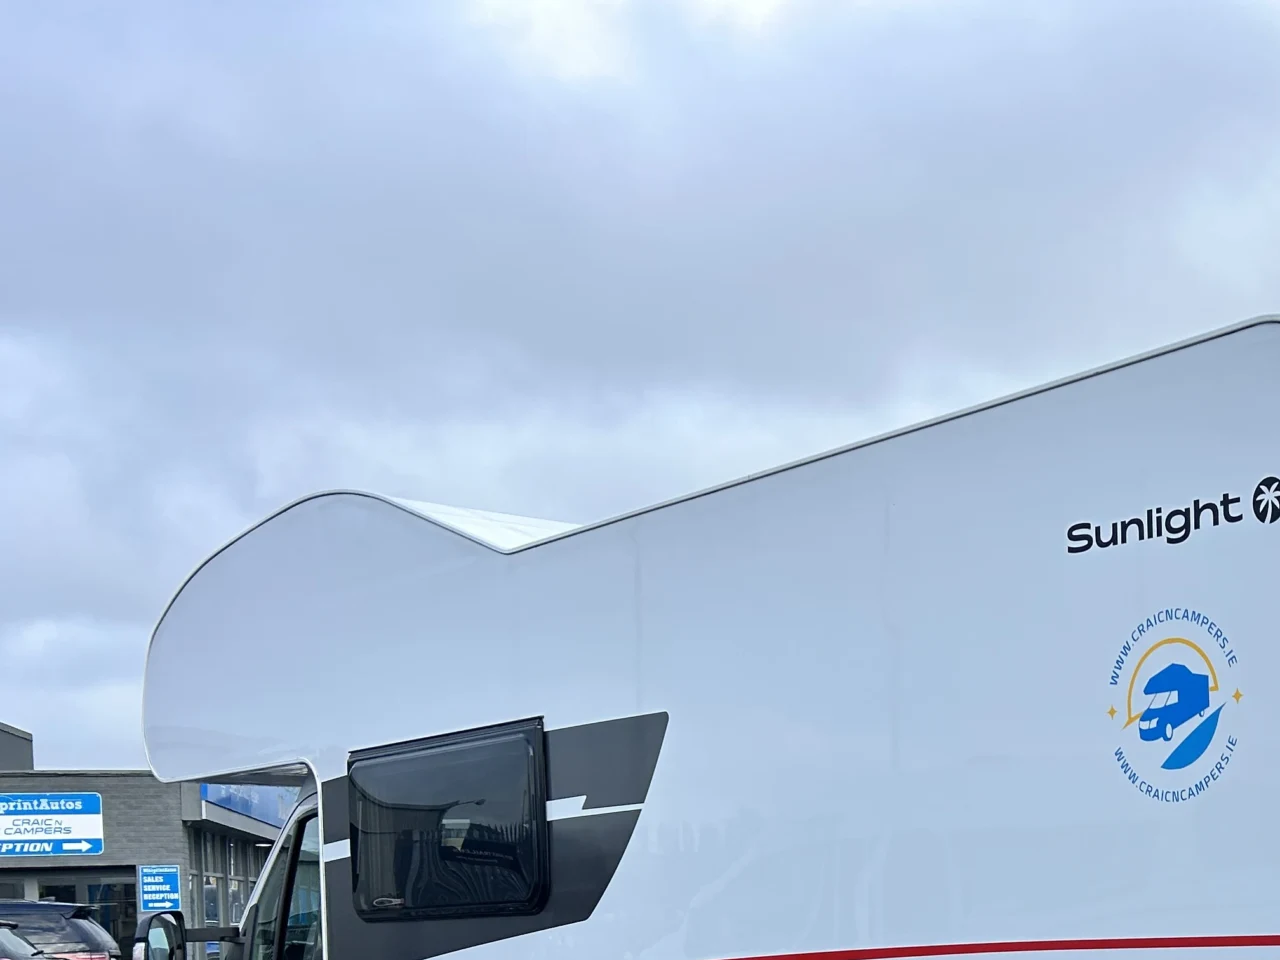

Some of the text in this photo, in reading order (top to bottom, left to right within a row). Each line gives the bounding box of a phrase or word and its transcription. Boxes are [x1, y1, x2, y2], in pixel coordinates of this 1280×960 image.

[1067, 492, 1243, 554] Sunlight
[1109, 607, 1238, 687] WWW.CRAICNCAMPERS.IE
[1114, 734, 1238, 804] WWW.CRAICNCAMPERS.IE
[0, 798, 83, 814] printAutos
[4, 826, 72, 835] CAMPERS
[12, 818, 53, 827] CRAIC
[143, 884, 171, 892] SERVICE
